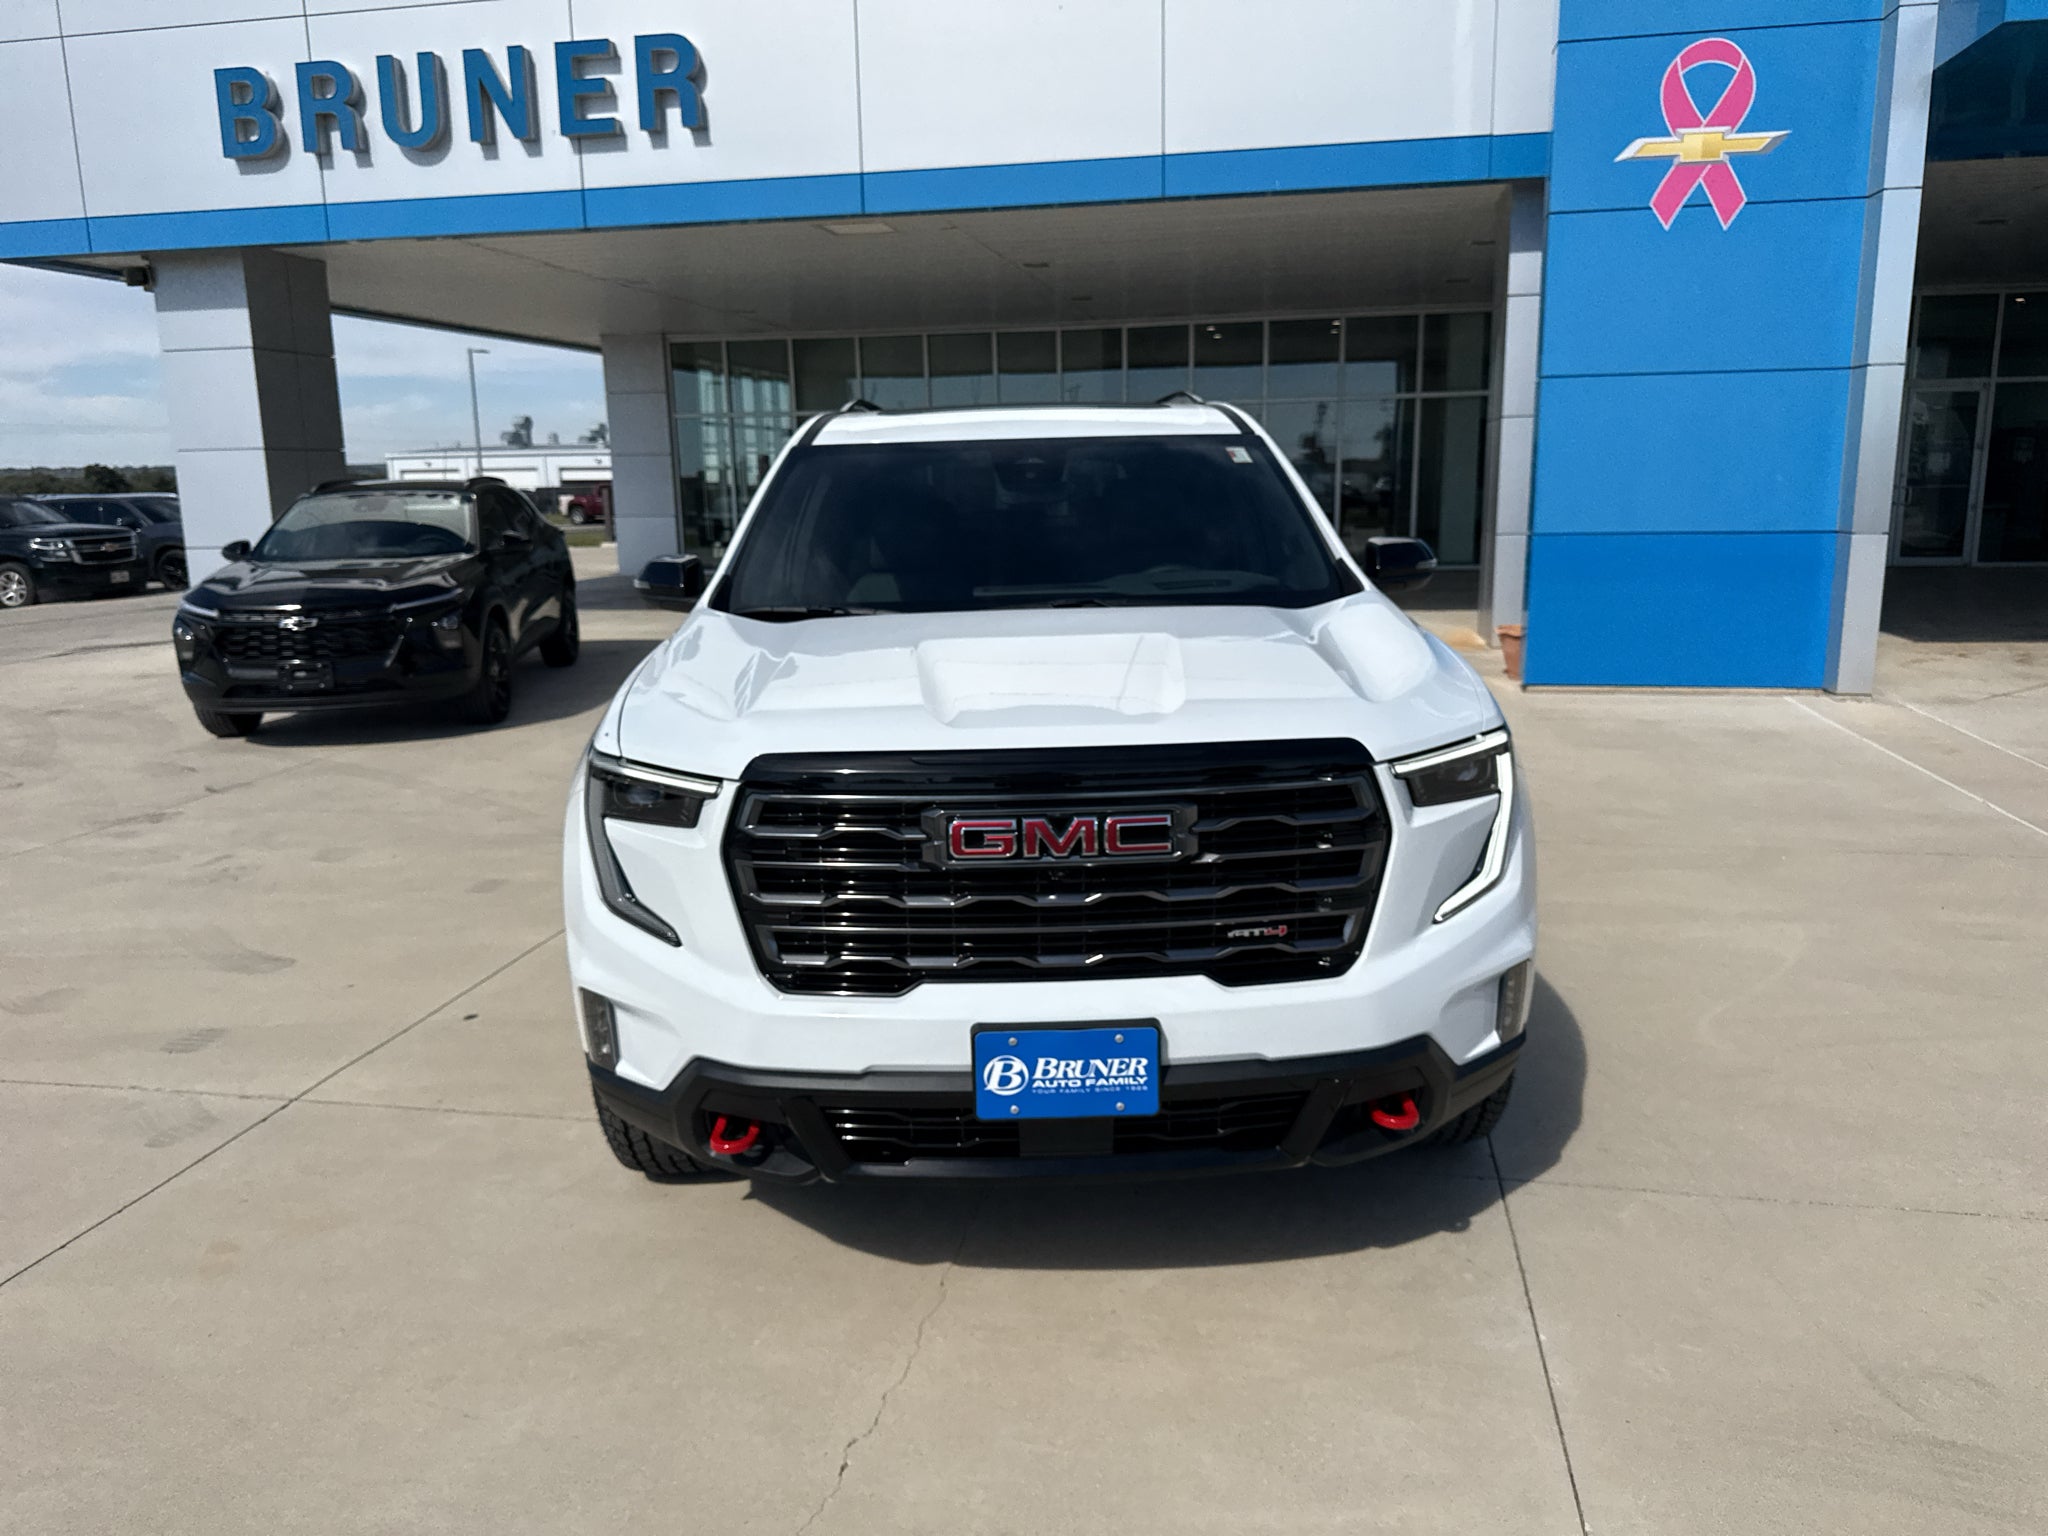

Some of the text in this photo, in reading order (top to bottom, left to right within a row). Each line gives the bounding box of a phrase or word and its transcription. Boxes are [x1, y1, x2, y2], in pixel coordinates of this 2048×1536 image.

[214, 33, 707, 159] BRUNER
[948, 814, 1173, 859] GMC
[1032, 1057, 1149, 1079] BRUNER
[1032, 1076, 1149, 1089] AUTO FAMILY
